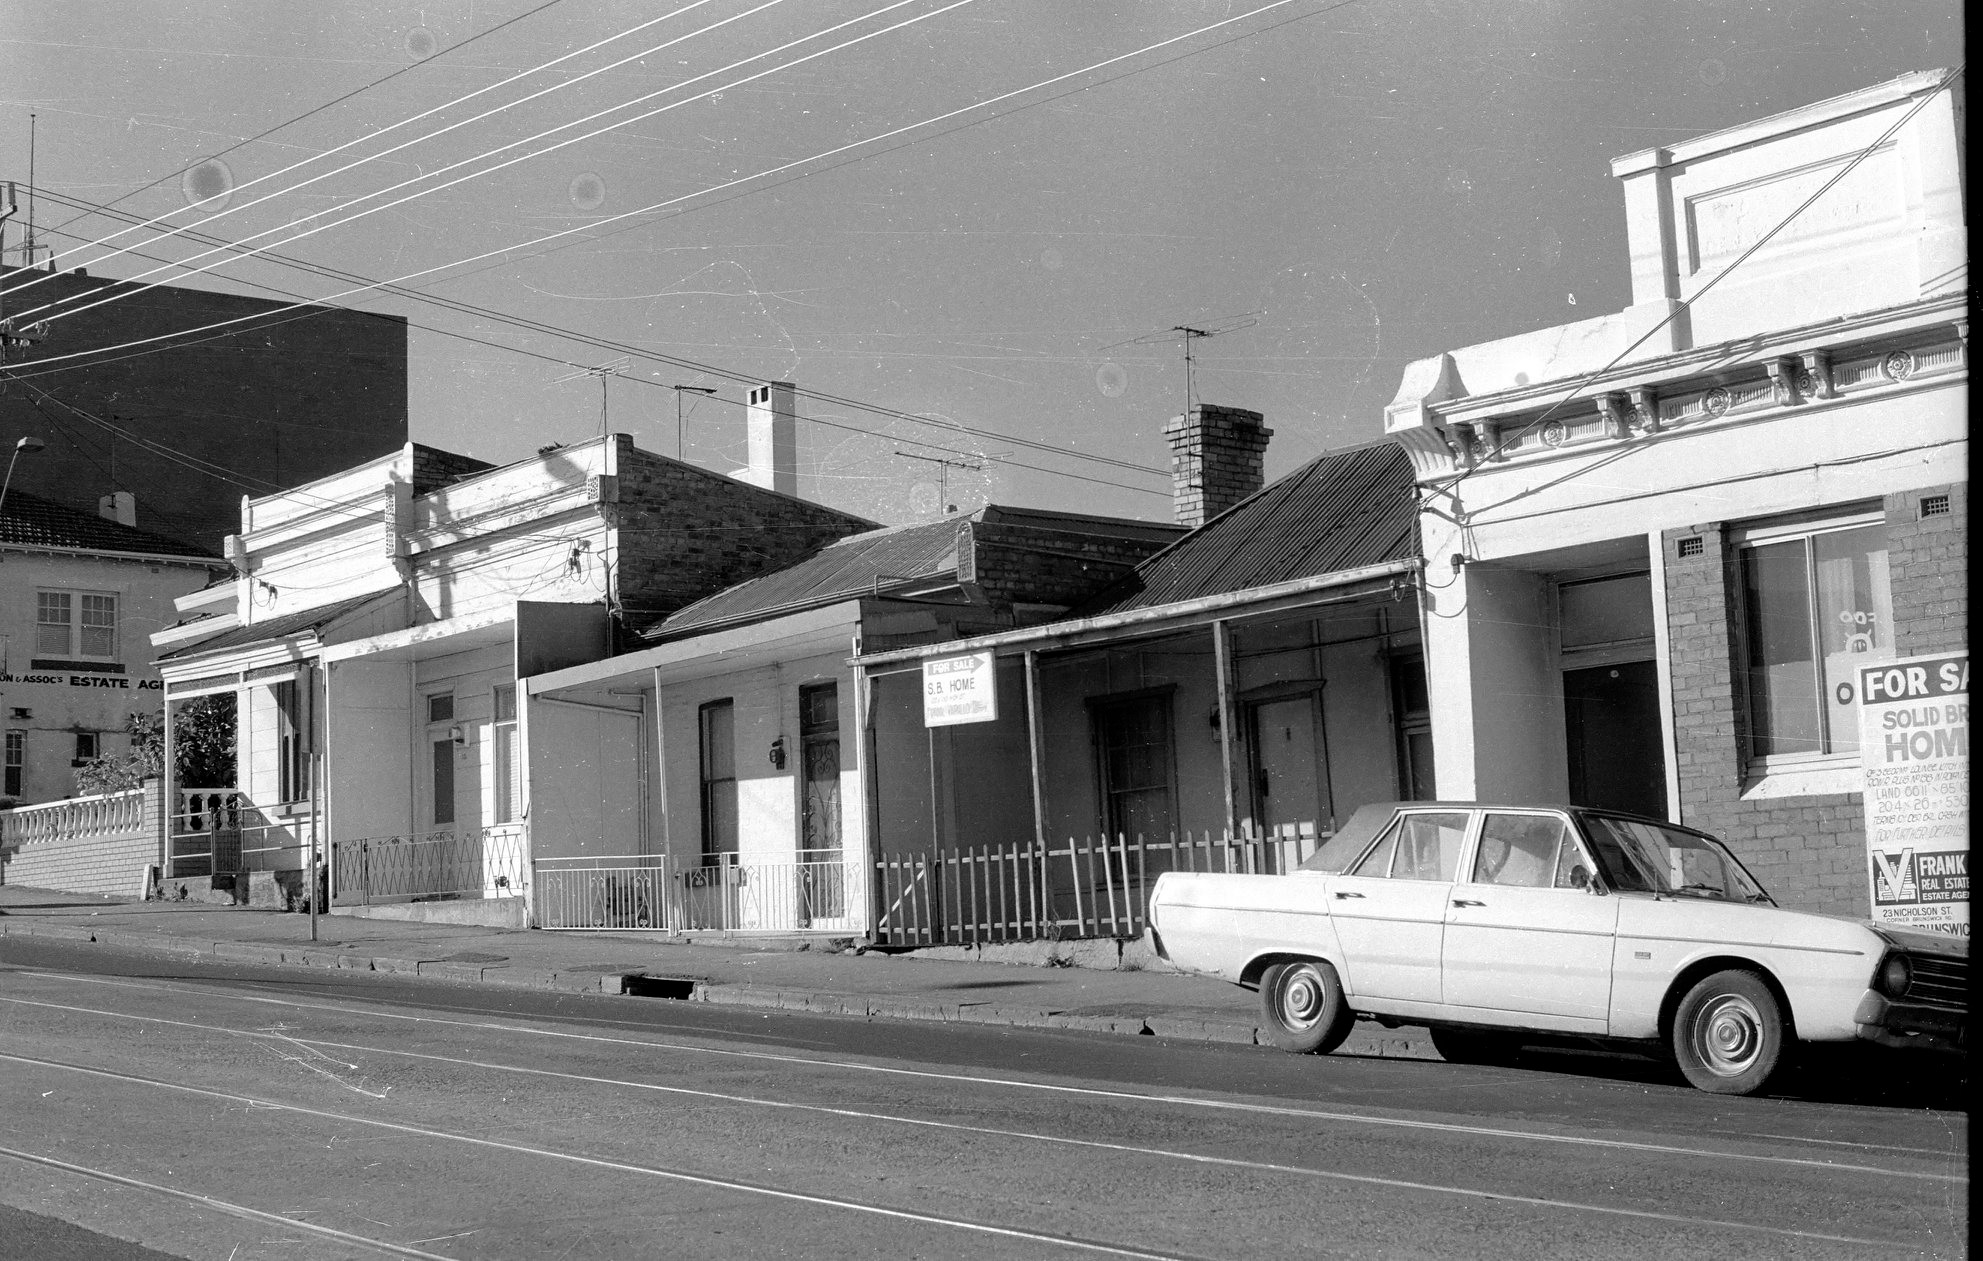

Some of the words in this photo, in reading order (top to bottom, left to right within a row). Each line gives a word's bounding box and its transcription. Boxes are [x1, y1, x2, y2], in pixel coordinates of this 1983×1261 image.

[932, 661, 950, 674] FOR
[953, 659, 975, 671] SALE
[70, 676, 129, 689] ESTATE
[950, 677, 975, 692] HOME
[1866, 666, 1929, 701] FOR
[1882, 706, 1940, 730] SOLID
[1885, 727, 1968, 763] HOM
[1876, 787, 1900, 800] LAND
[1919, 855, 1967, 876] FRANK
[1921, 878, 1940, 890] REAL
[1922, 892, 1950, 901] ESTATE
[1883, 909, 1893, 918] 23
[1894, 907, 1938, 917] NICHOLSON
